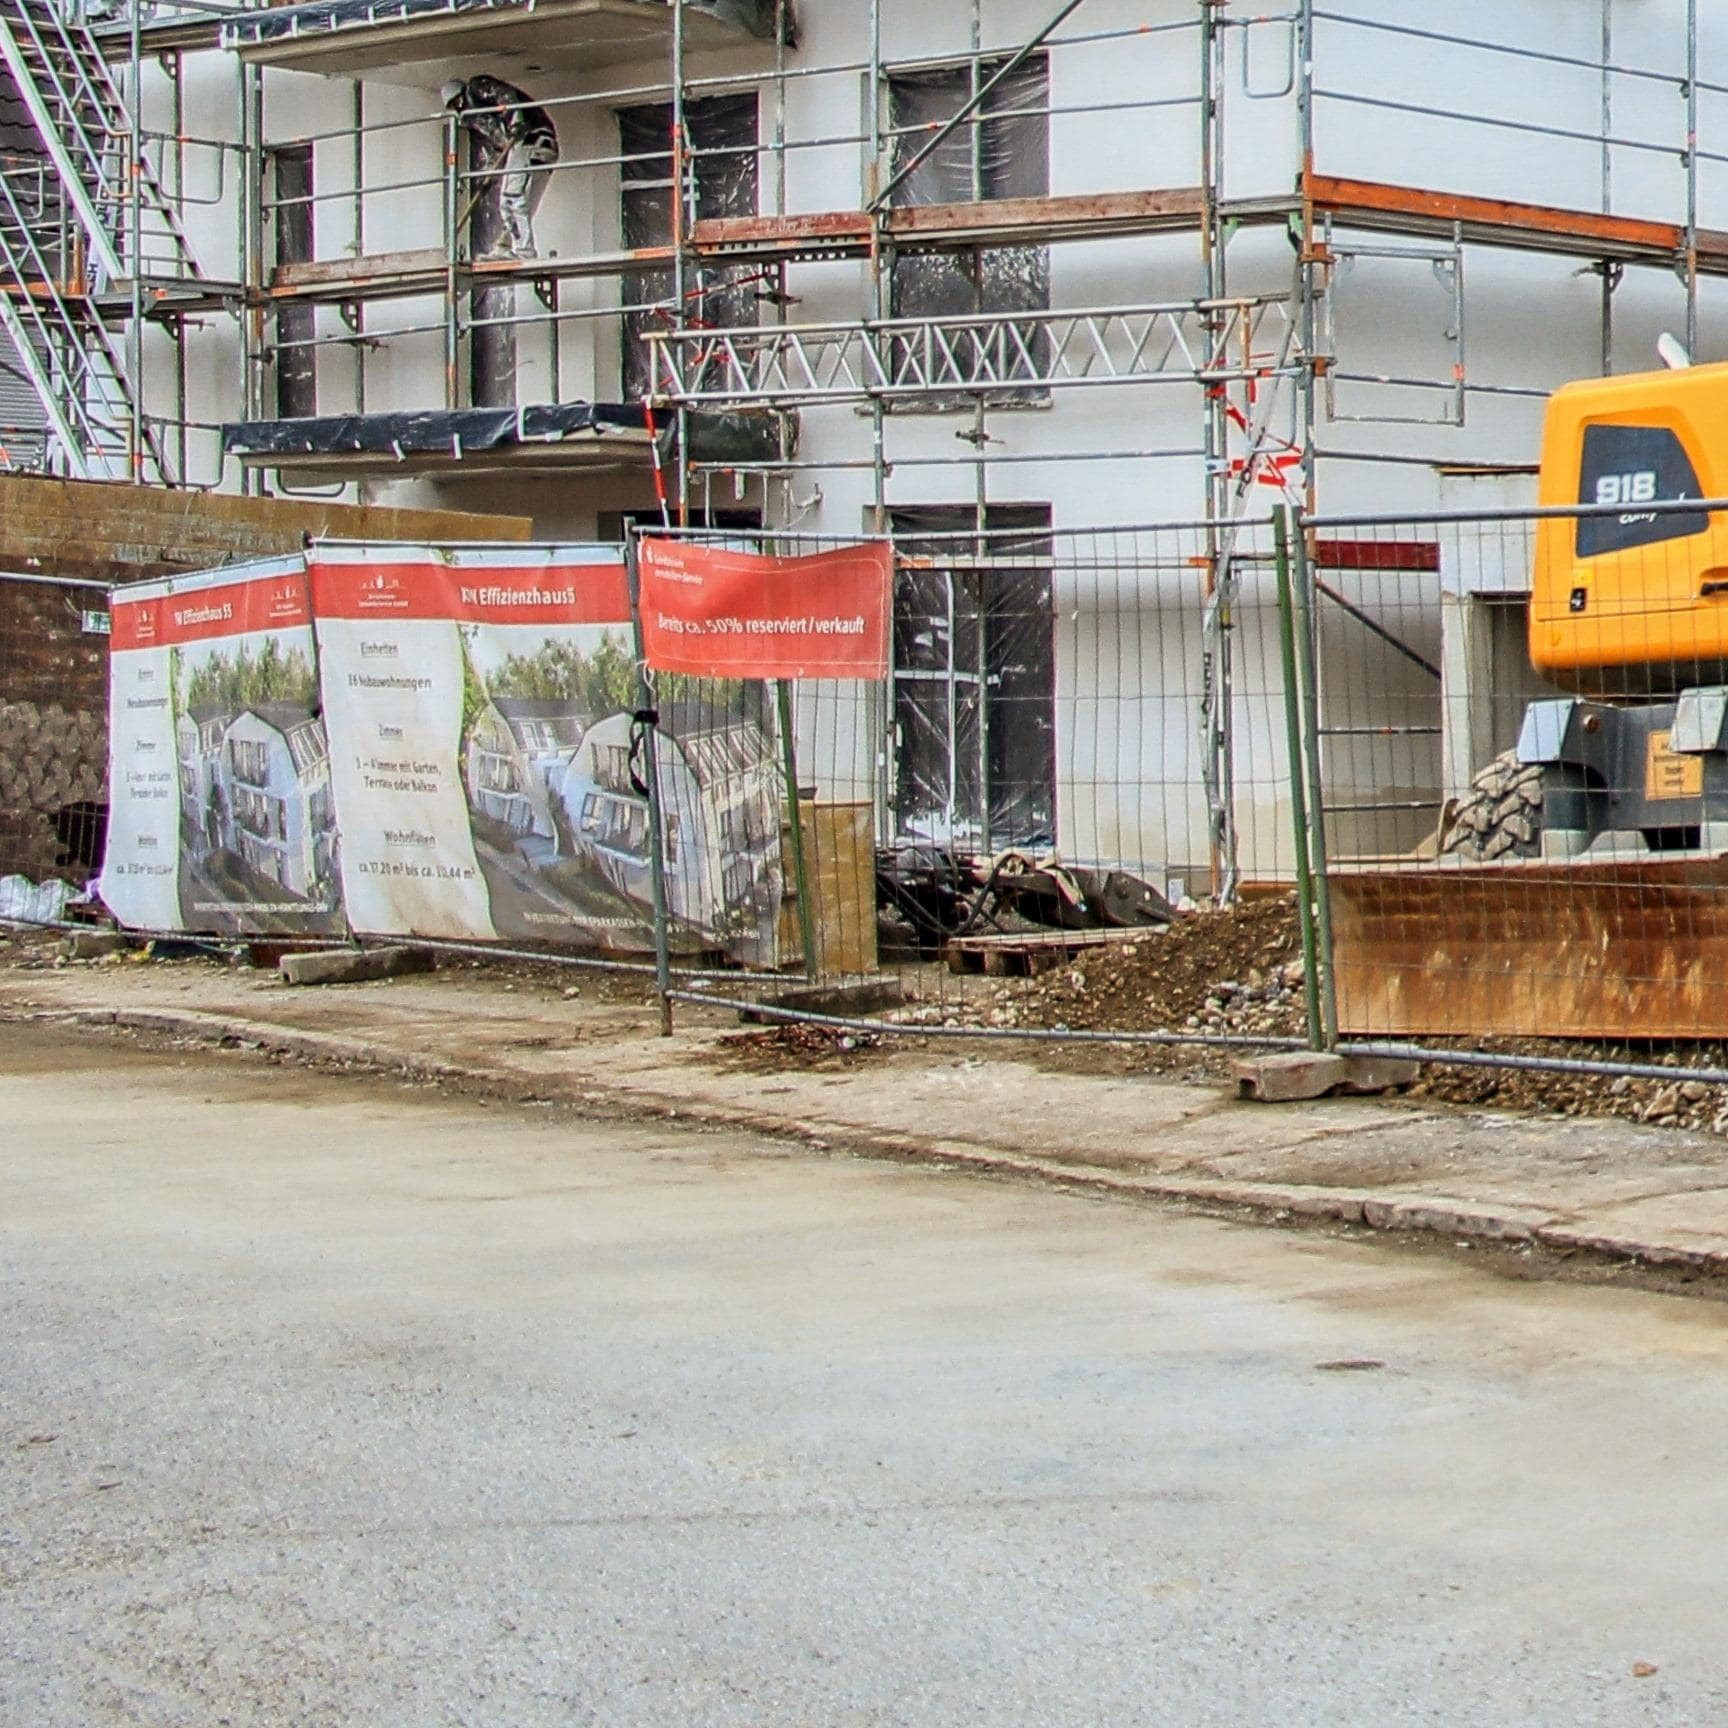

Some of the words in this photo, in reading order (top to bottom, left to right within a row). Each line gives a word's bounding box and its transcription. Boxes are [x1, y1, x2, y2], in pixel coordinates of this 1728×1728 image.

[1596, 471, 1657, 504] 918
[478, 586, 568, 606] Effizienzhaus
[705, 617, 743, 634] 50%
